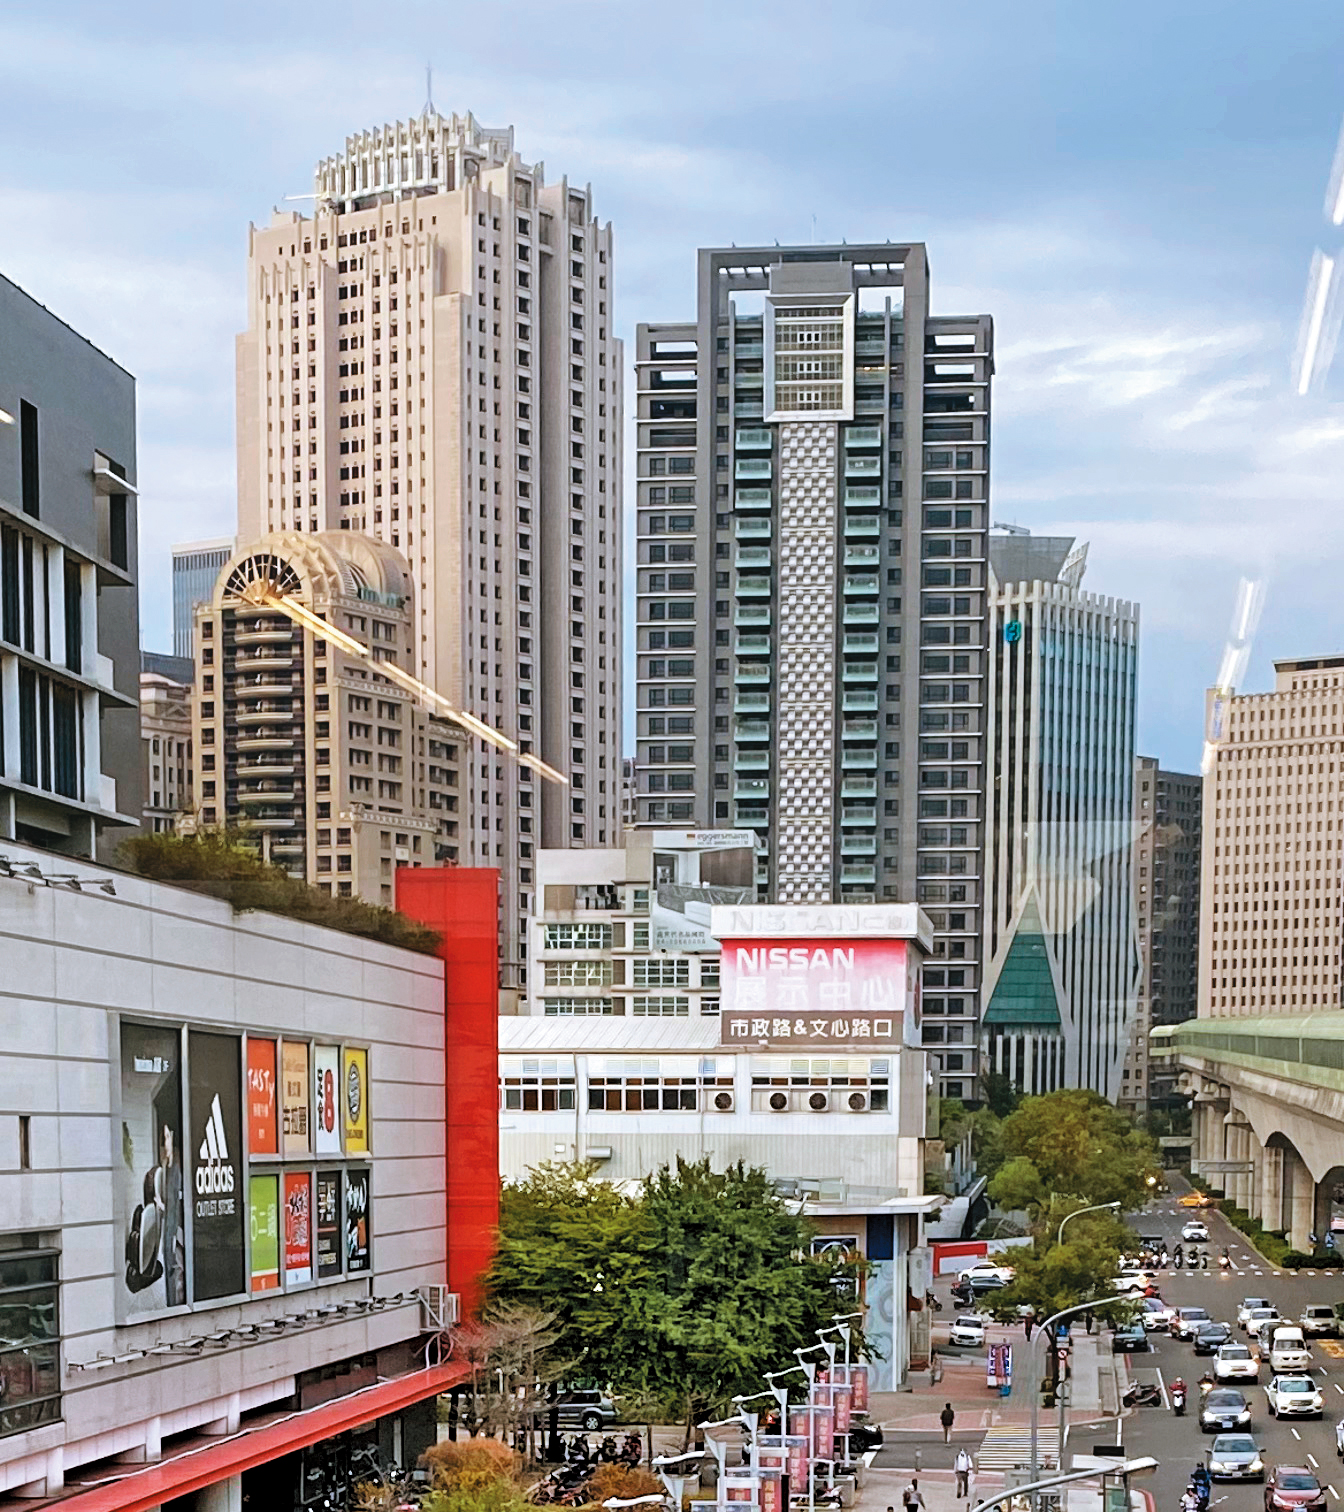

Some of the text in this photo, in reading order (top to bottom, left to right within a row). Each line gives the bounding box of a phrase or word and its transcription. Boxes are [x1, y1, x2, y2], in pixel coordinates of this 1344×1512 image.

[736, 947, 855, 971] NISSAN
[734, 974, 896, 1011] 展示中心
[730, 1017, 894, 1039] 市政路&文心路口
[195, 1157, 236, 1195] adidas
